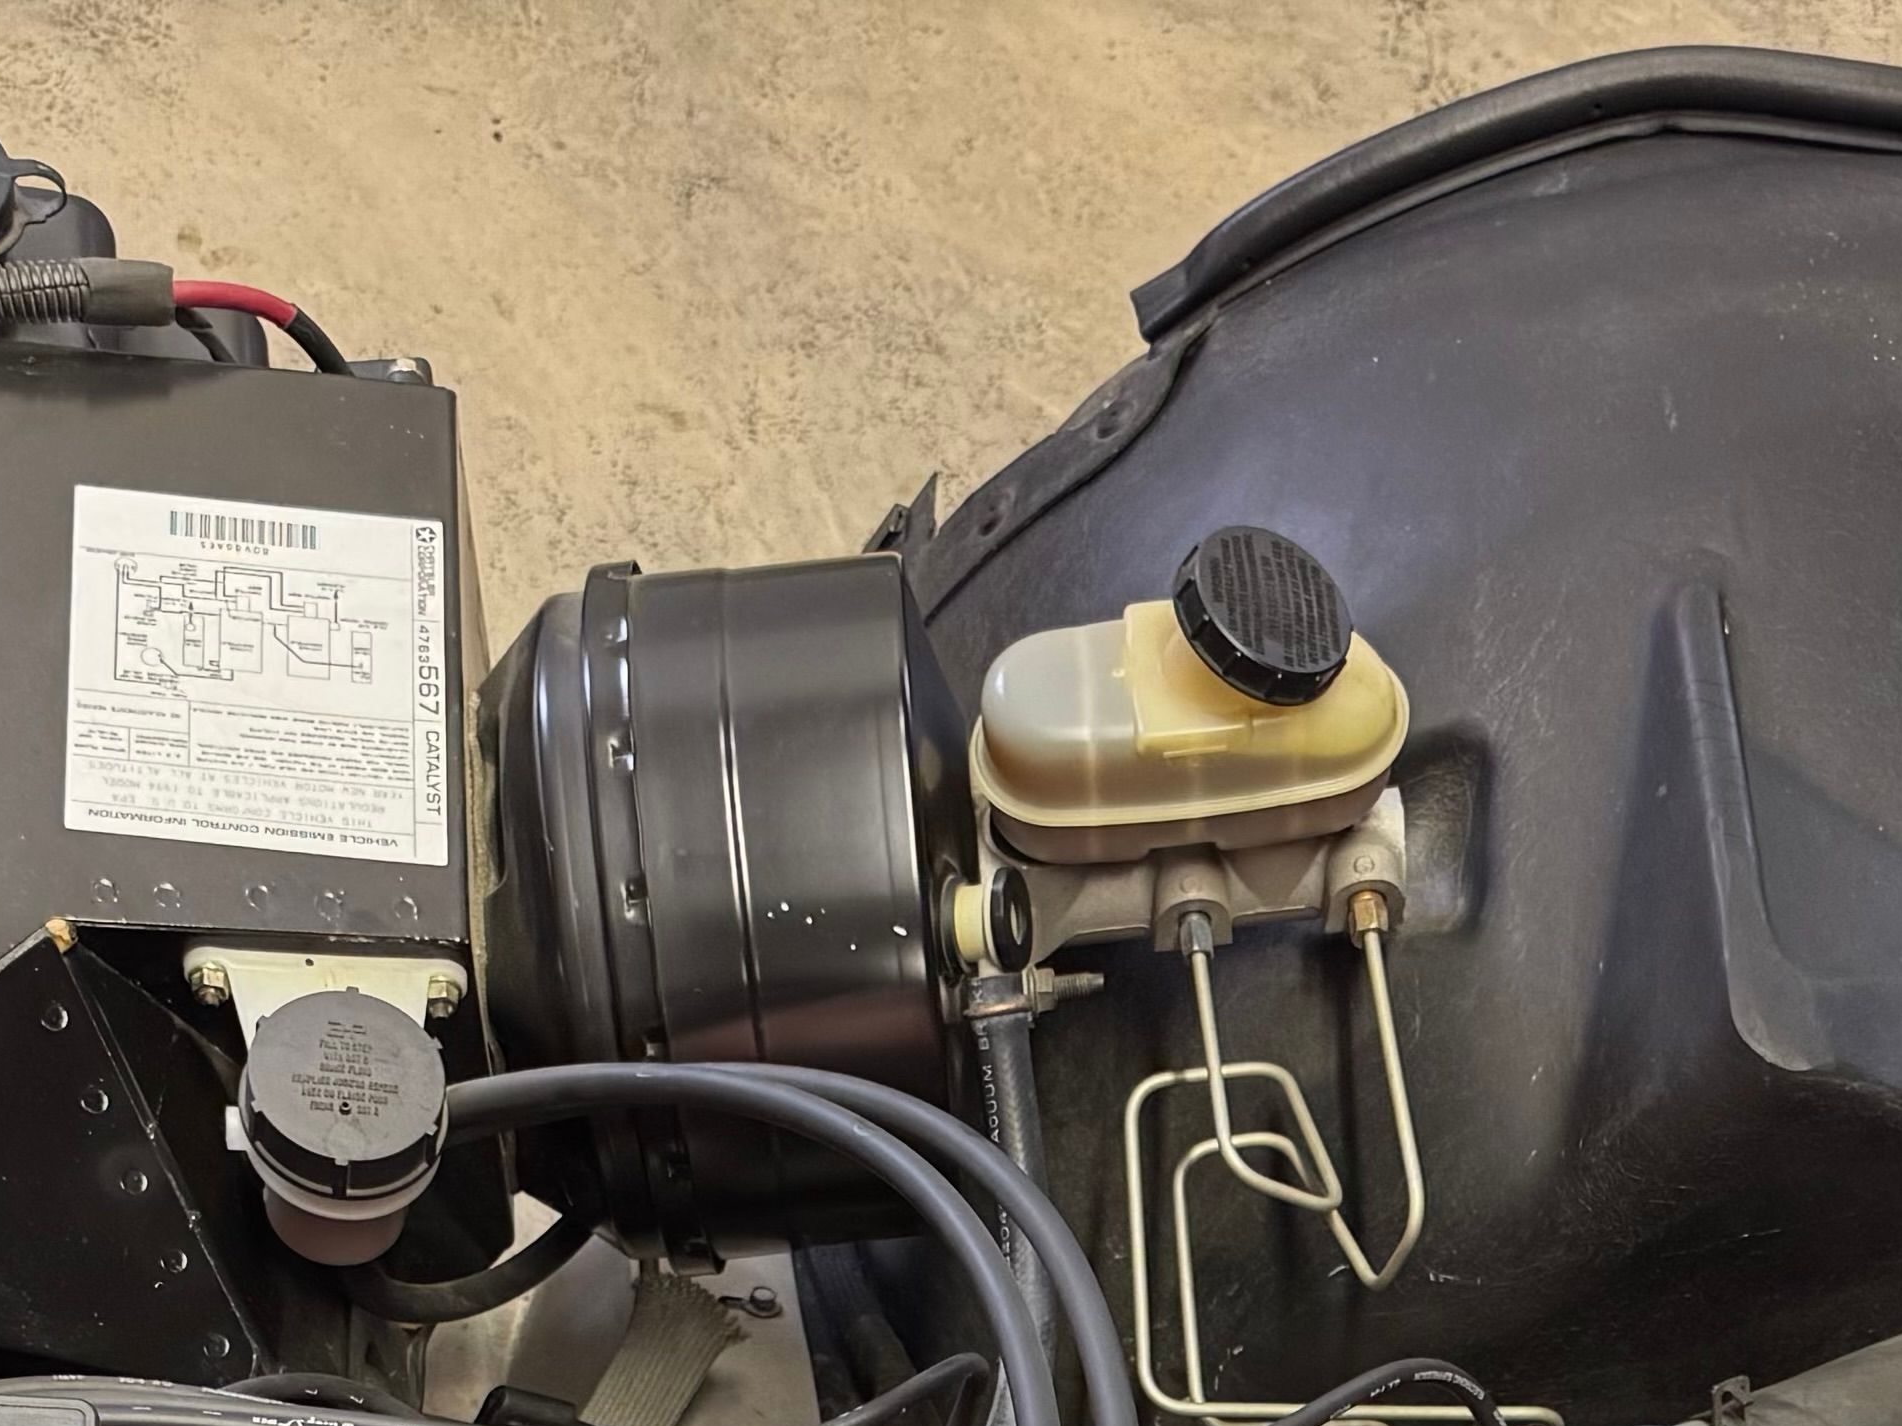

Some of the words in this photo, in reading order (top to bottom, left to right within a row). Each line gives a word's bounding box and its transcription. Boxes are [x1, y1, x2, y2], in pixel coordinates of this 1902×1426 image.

[425, 730, 442, 817] CATALYST
[87, 807, 188, 828] INFORMATION
[194, 818, 260, 834] CONTROL
[264, 826, 335, 842] EMISSION
[339, 834, 399, 848] VEHICLE
